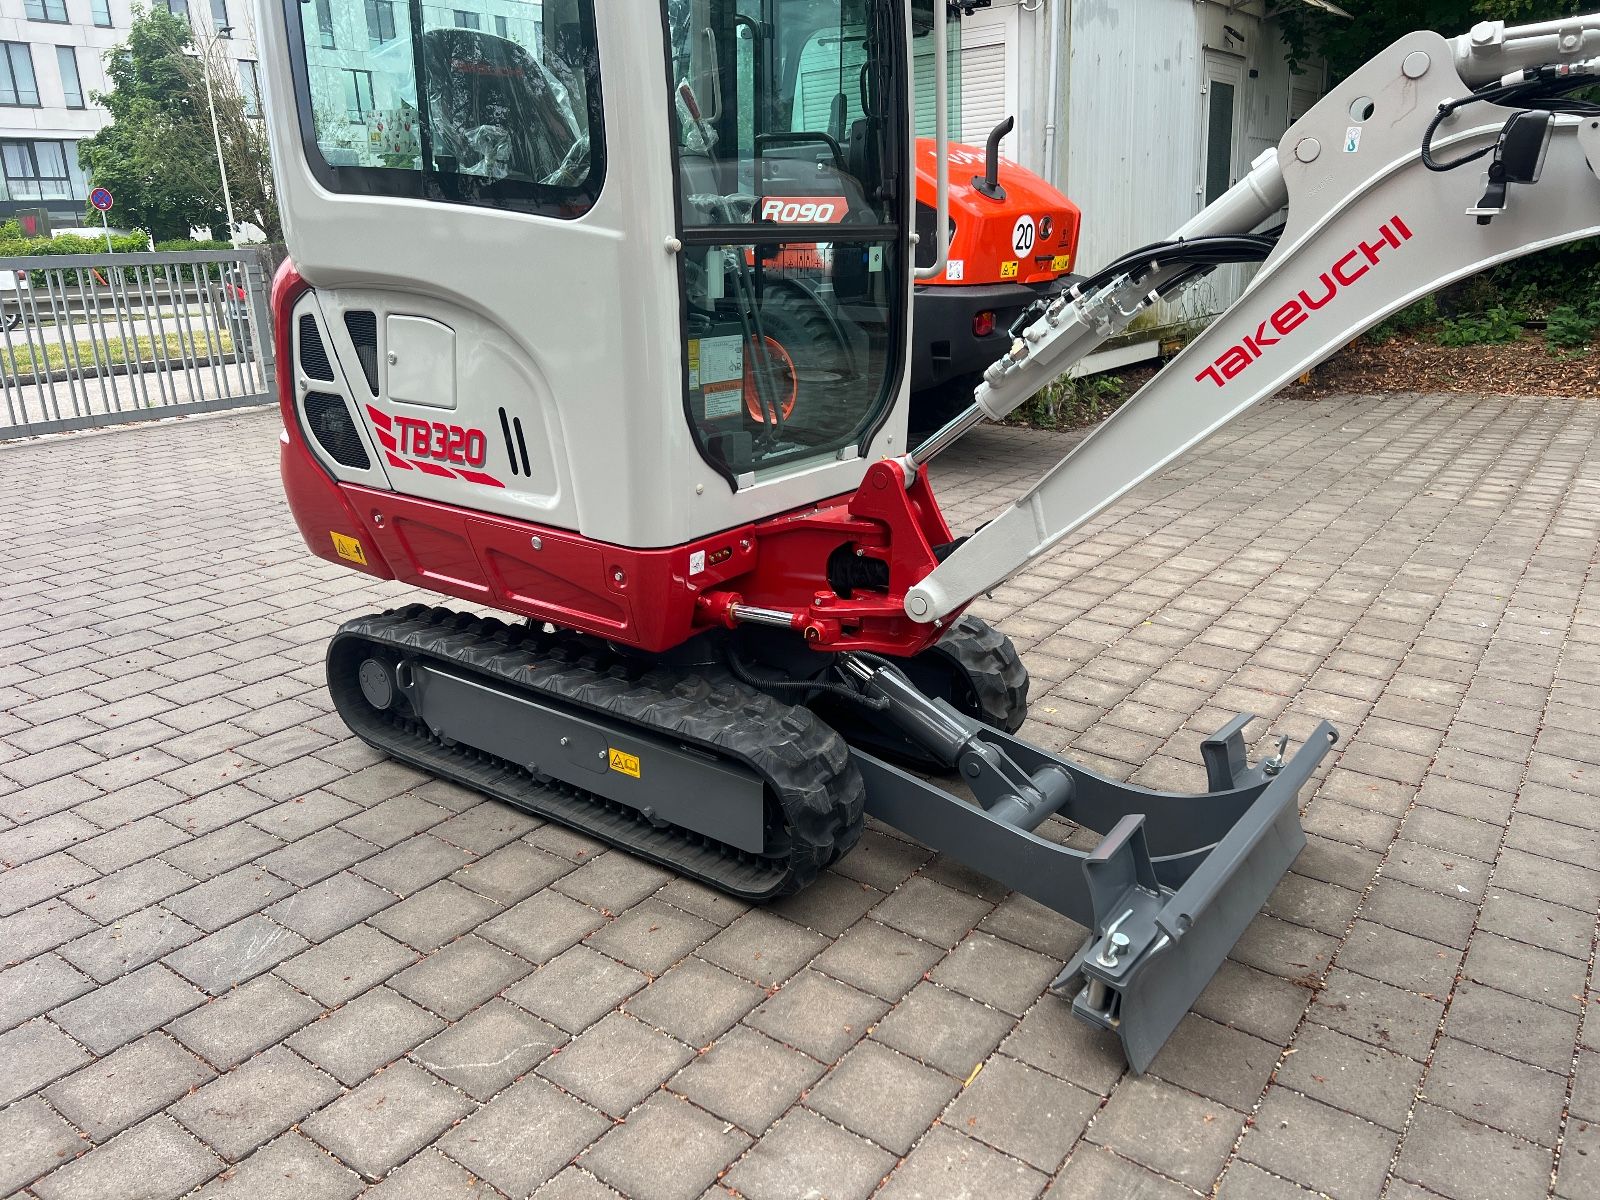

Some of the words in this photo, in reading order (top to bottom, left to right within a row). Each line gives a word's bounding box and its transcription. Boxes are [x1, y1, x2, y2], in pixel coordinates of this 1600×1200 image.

[762, 201, 834, 222] R090
[1015, 223, 1033, 250] 20
[394, 415, 487, 469] TB320
